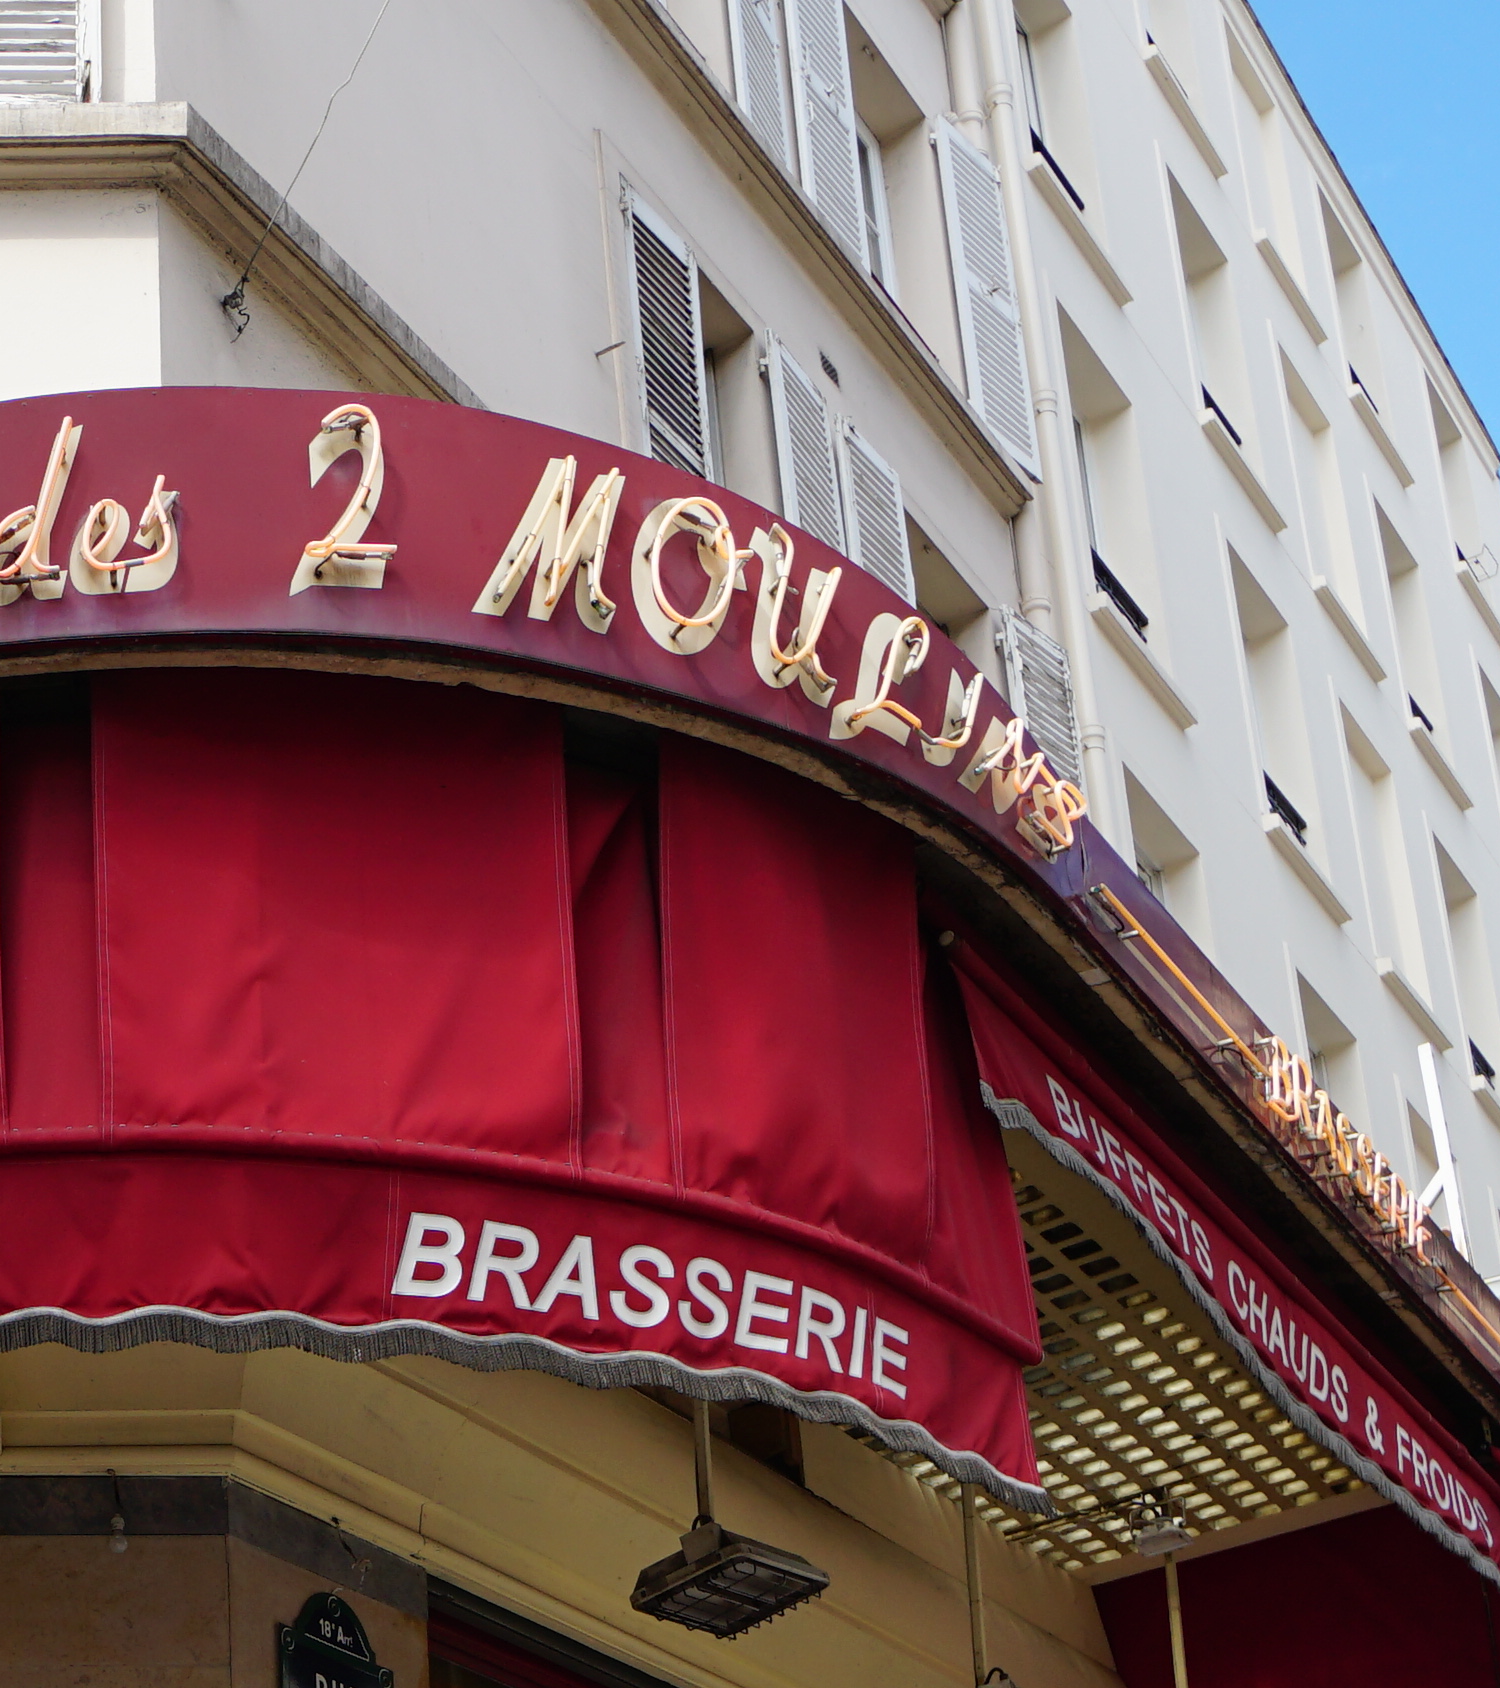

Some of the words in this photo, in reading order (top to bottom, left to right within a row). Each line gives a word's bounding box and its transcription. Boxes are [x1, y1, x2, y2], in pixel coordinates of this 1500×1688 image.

[289, 404, 398, 597] 2
[472, 454, 1088, 862] MOULINS
[392, 1212, 909, 1399] BRASSERIE
[1046, 1074, 1214, 1281] BUFFETS
[1228, 1260, 1348, 1423] CHAUDS
[1364, 1396, 1385, 1456] &
[1396, 1423, 1495, 1548] FROIDS
